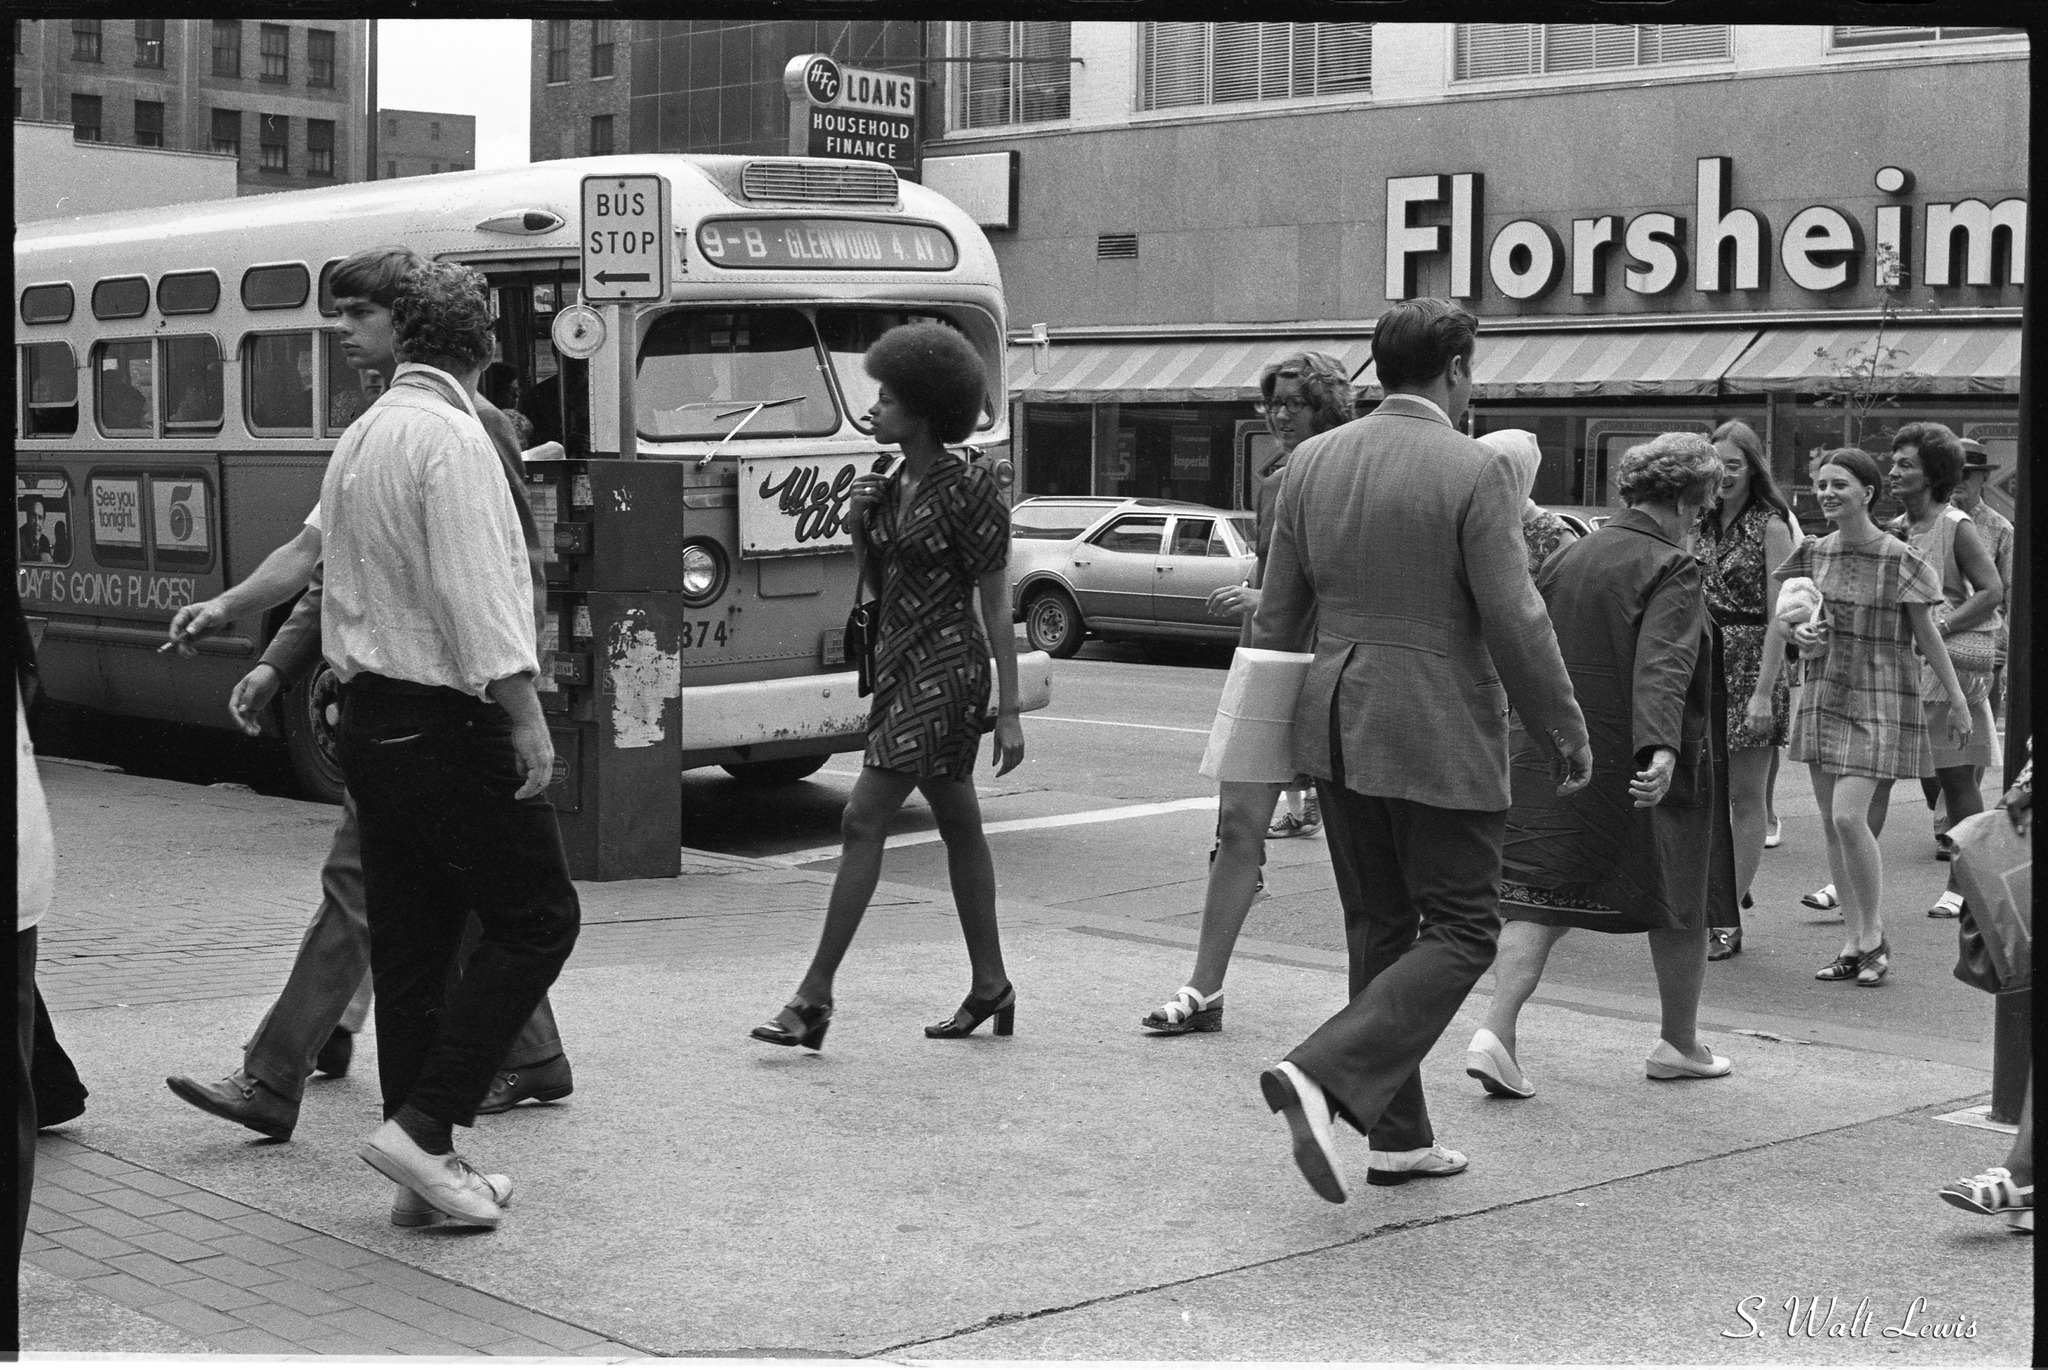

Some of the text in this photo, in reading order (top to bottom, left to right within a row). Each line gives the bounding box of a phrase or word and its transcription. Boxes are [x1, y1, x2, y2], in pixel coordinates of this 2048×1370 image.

[810, 63, 838, 98] HFC
[847, 74, 911, 109] LOANS
[813, 113, 910, 139] HOUSEHOLD
[826, 136, 897, 159] FINANCE
[597, 192, 645, 217] BUS
[590, 230, 655, 254] STOP
[784, 227, 882, 260] GLENWOOD
[1385, 156, 2028, 300] Florsheim
[95, 485, 136, 511] See you
[759, 464, 855, 511] Wel
[99, 507, 136, 532] tonight.
[169, 484, 193, 541] 5
[52, 570, 66, 602] IS
[70, 571, 122, 606] GOING
[128, 576, 195, 610] PLACES!
